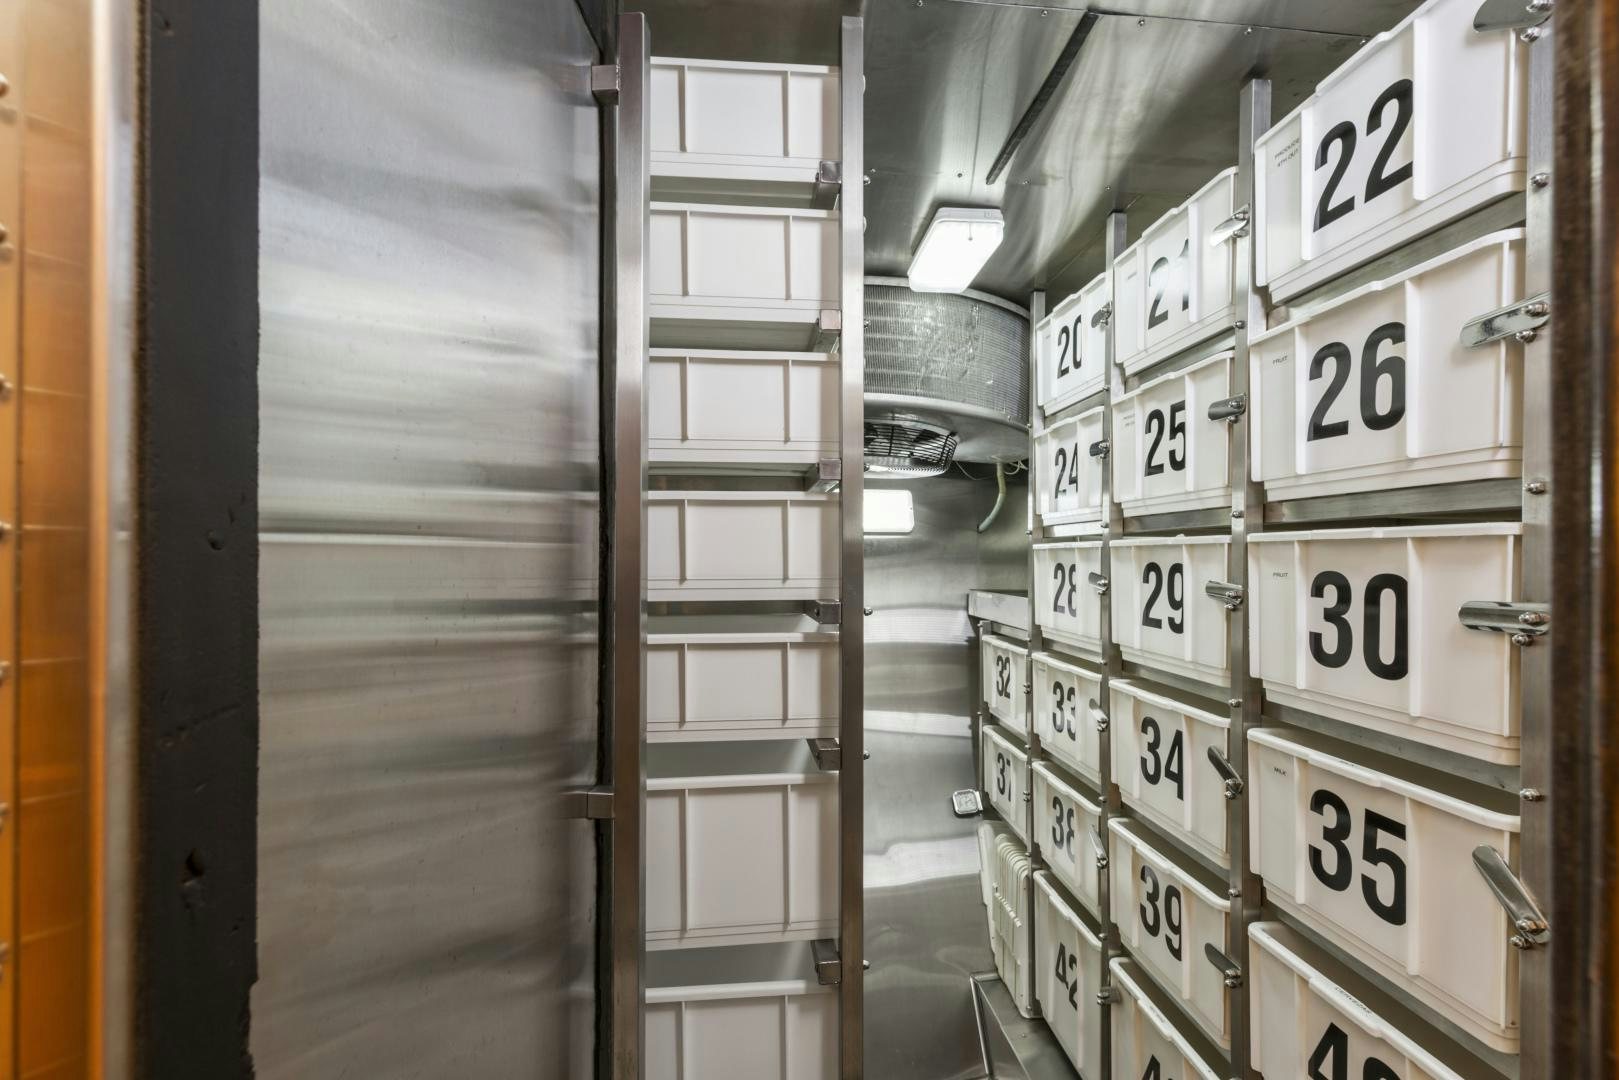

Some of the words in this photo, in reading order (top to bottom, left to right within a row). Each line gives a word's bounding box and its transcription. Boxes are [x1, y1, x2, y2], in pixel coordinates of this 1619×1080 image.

[1313, 77, 1413, 232] 22
[1148, 238, 1189, 329] 21
[1057, 314, 1082, 378] 20
[1307, 321, 1405, 442] 26
[1054, 442, 1079, 499] 24
[1144, 400, 1186, 477] 25
[1053, 562, 1077, 618] 28
[1142, 561, 1184, 634] 29
[1309, 570, 1408, 680] 30
[996, 654, 1011, 699] 32
[1052, 680, 1076, 742] 33
[997, 751, 1011, 802] 37
[1140, 716, 1184, 801] 34
[1052, 795, 1076, 864] 38
[1308, 789, 1407, 926] 35
[1139, 864, 1183, 962] 39
[1055, 941, 1078, 1012] 42
[1308, 1022, 1402, 1080] 4
